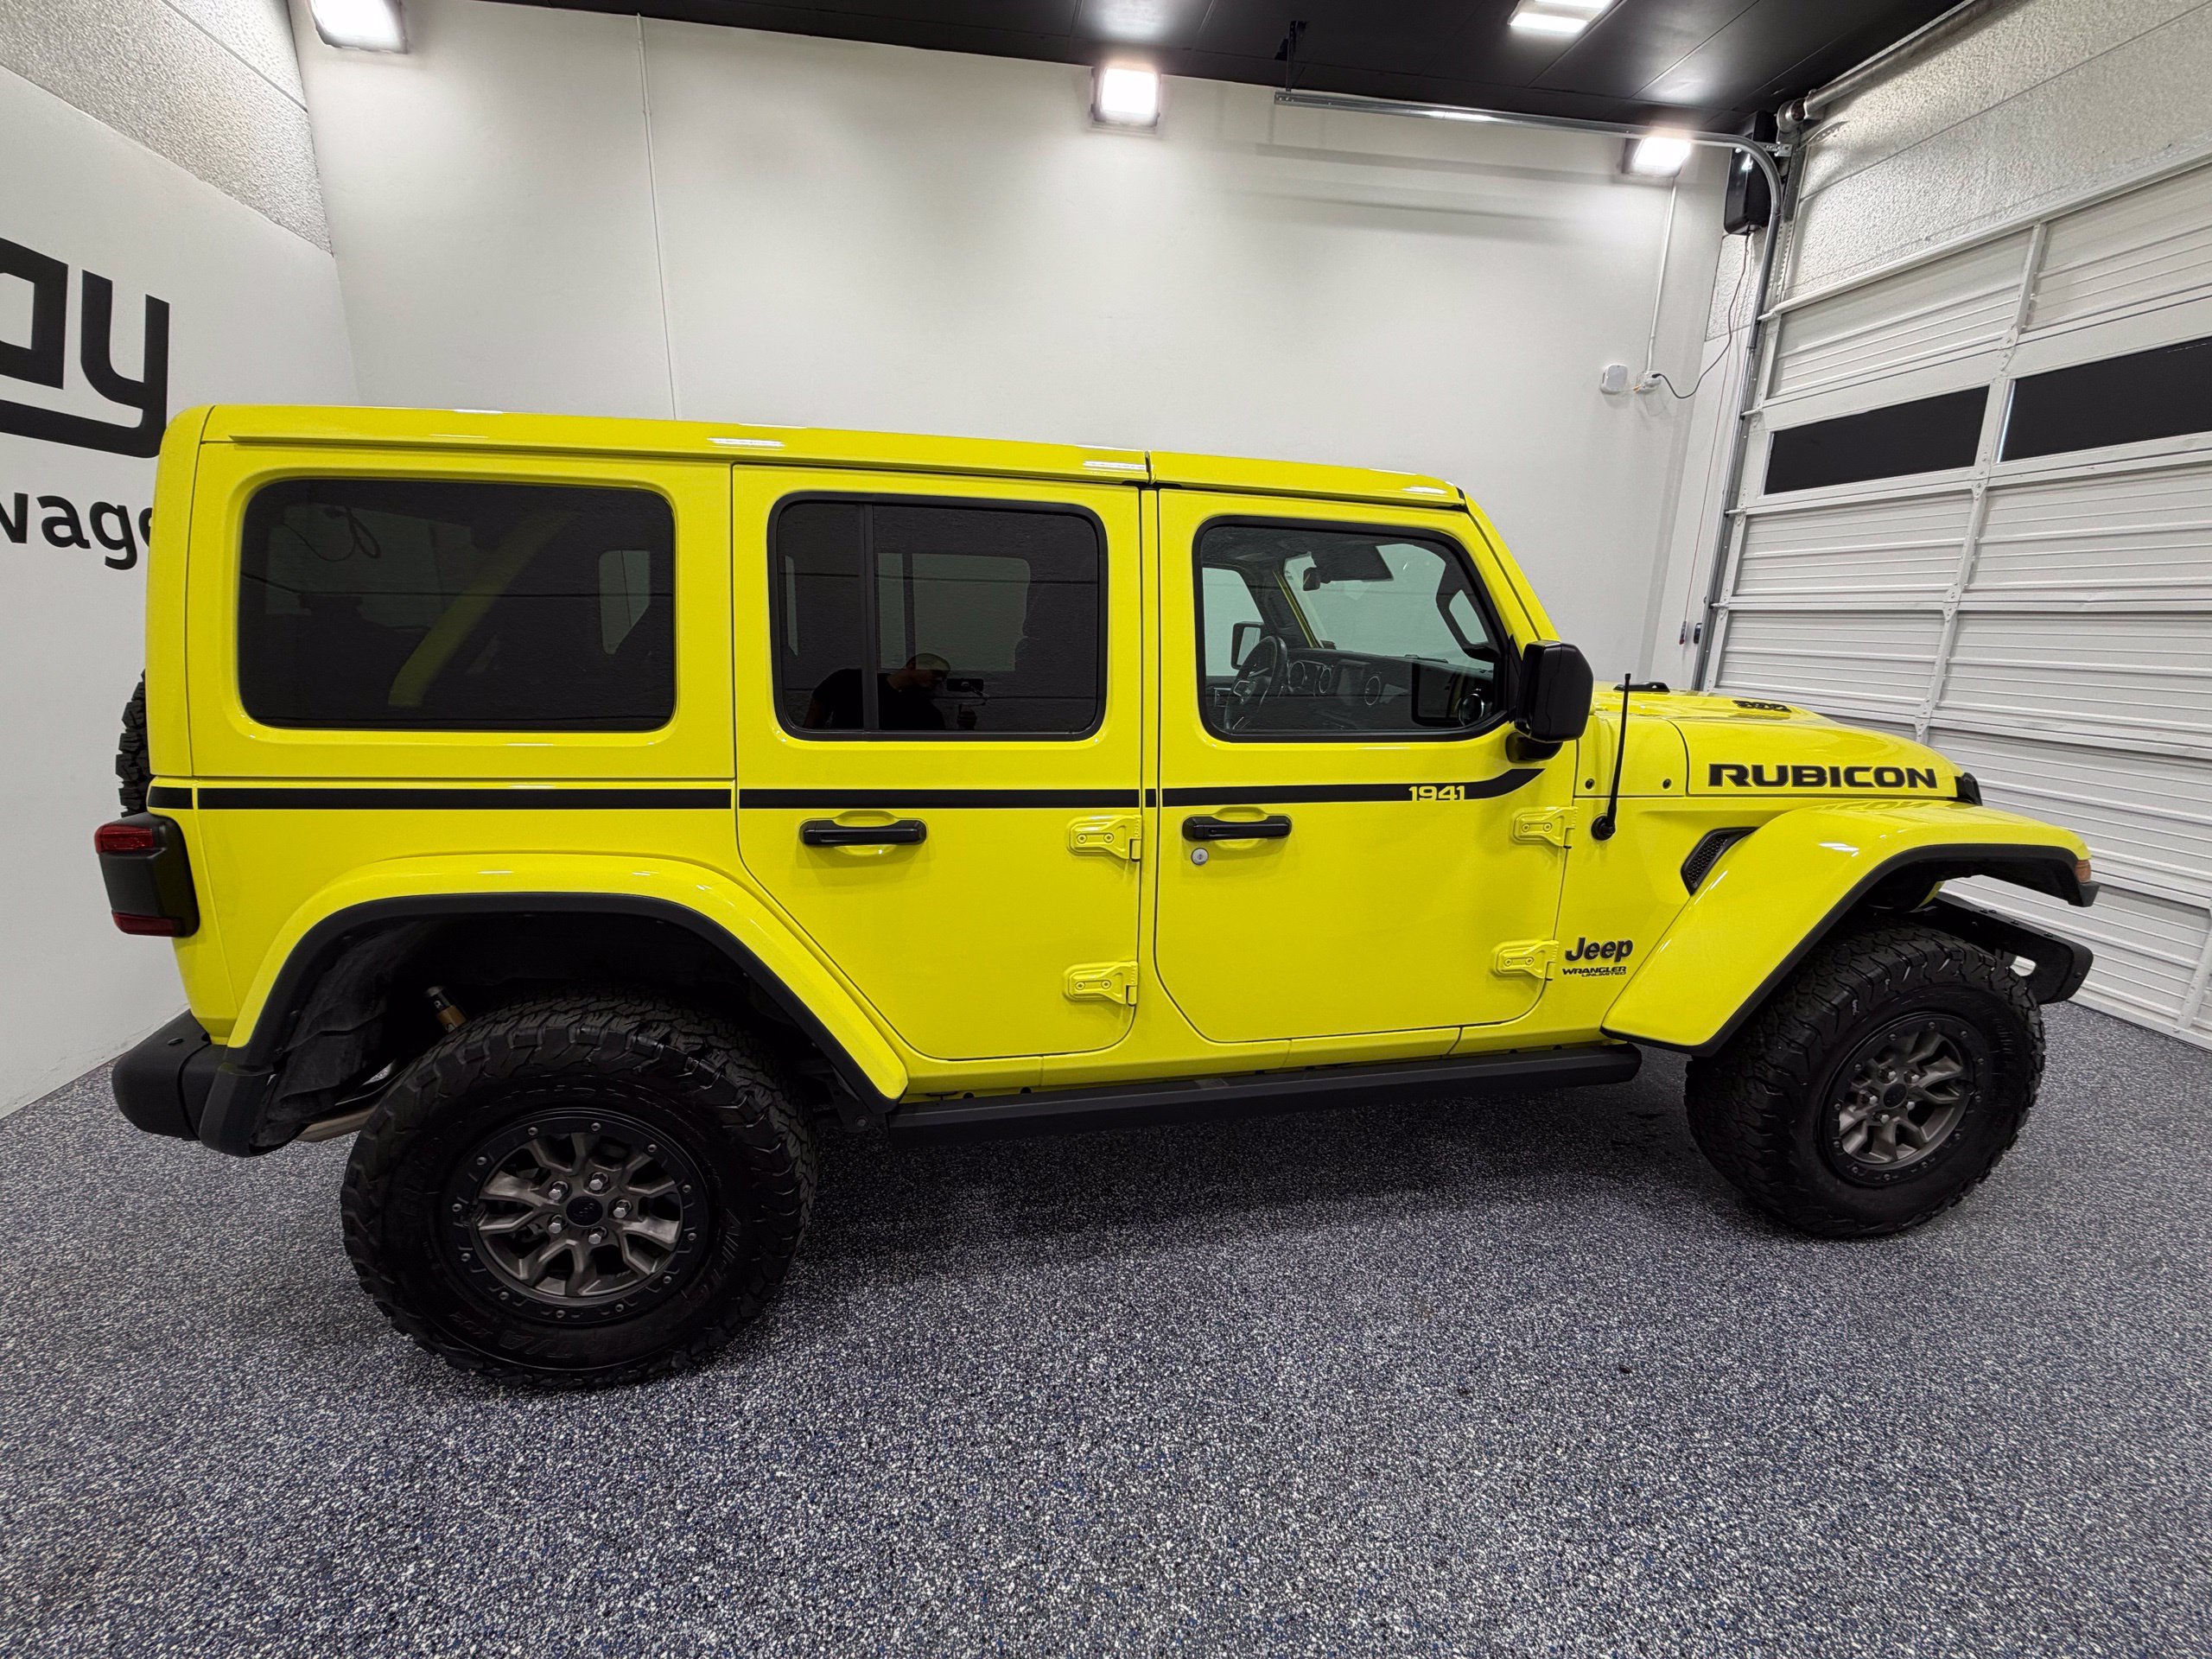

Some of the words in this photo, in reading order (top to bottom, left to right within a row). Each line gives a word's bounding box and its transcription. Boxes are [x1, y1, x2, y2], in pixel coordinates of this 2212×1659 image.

[1707, 763, 1938, 789] RUBICON
[1408, 785, 1465, 802] 1941
[1565, 937, 1633, 963] Jeep
[1562, 966, 1626, 976] WRANGLER
